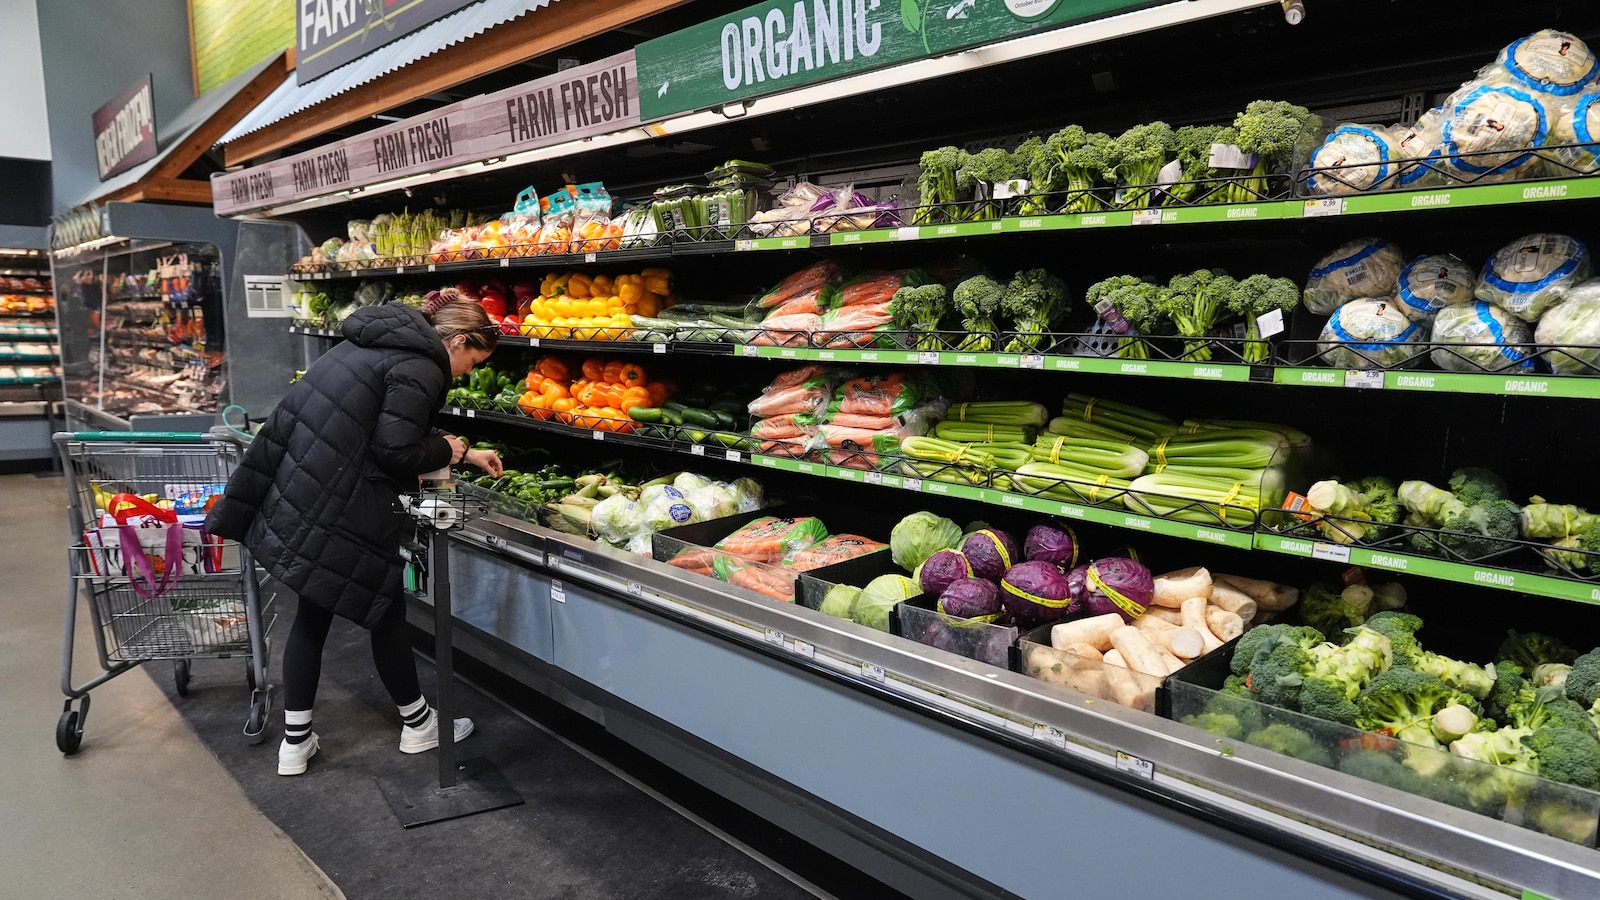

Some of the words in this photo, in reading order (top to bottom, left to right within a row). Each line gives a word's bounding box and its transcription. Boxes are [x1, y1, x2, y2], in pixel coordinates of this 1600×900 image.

[721, 0, 882, 90] ORGANIC
[506, 88, 558, 143] FARM
[560, 66, 629, 131] FRESH
[373, 130, 408, 173] FARM
[408, 117, 453, 164] FRESH
[292, 158, 318, 193] FARM
[317, 149, 350, 187] FRESH
[230, 176, 249, 206] FARM
[250, 170, 274, 201] FRESH
[1523, 185, 1567, 199] ORGANIC
[1412, 193, 1450, 207] ORGANIC
[1163, 212, 1177, 221] ANIC
[1227, 208, 1257, 218] ORGANIC
[1019, 219, 1042, 228] ORGANIC
[1081, 215, 1106, 225] ORGANIC
[937, 225, 957, 234] ORGANIC
[844, 233, 860, 242] ORGANIC
[906, 354, 918, 362] ORGA
[956, 355, 976, 363] ORGANIC
[997, 357, 1018, 365] ORGANIC
[1056, 360, 1080, 369] ORGANIC
[1121, 363, 1147, 373] ORGANIC
[1194, 367, 1223, 377] ORGANIC
[1302, 372, 1335, 383] ORGANIC
[1397, 376, 1435, 388] ORGANIC
[1505, 380, 1548, 392] ORGANIC
[929, 483, 947, 493] ORGANIC
[1002, 495, 1023, 506] ORGANIC
[1061, 506, 1084, 517] ORGANIC
[1125, 517, 1151, 529] ORGANIC
[1197, 529, 1225, 542] ORGANIC
[1280, 540, 1312, 554] ORGANIC
[1371, 554, 1407, 569] ORGANIC
[1474, 570, 1514, 586] ORGANIC
